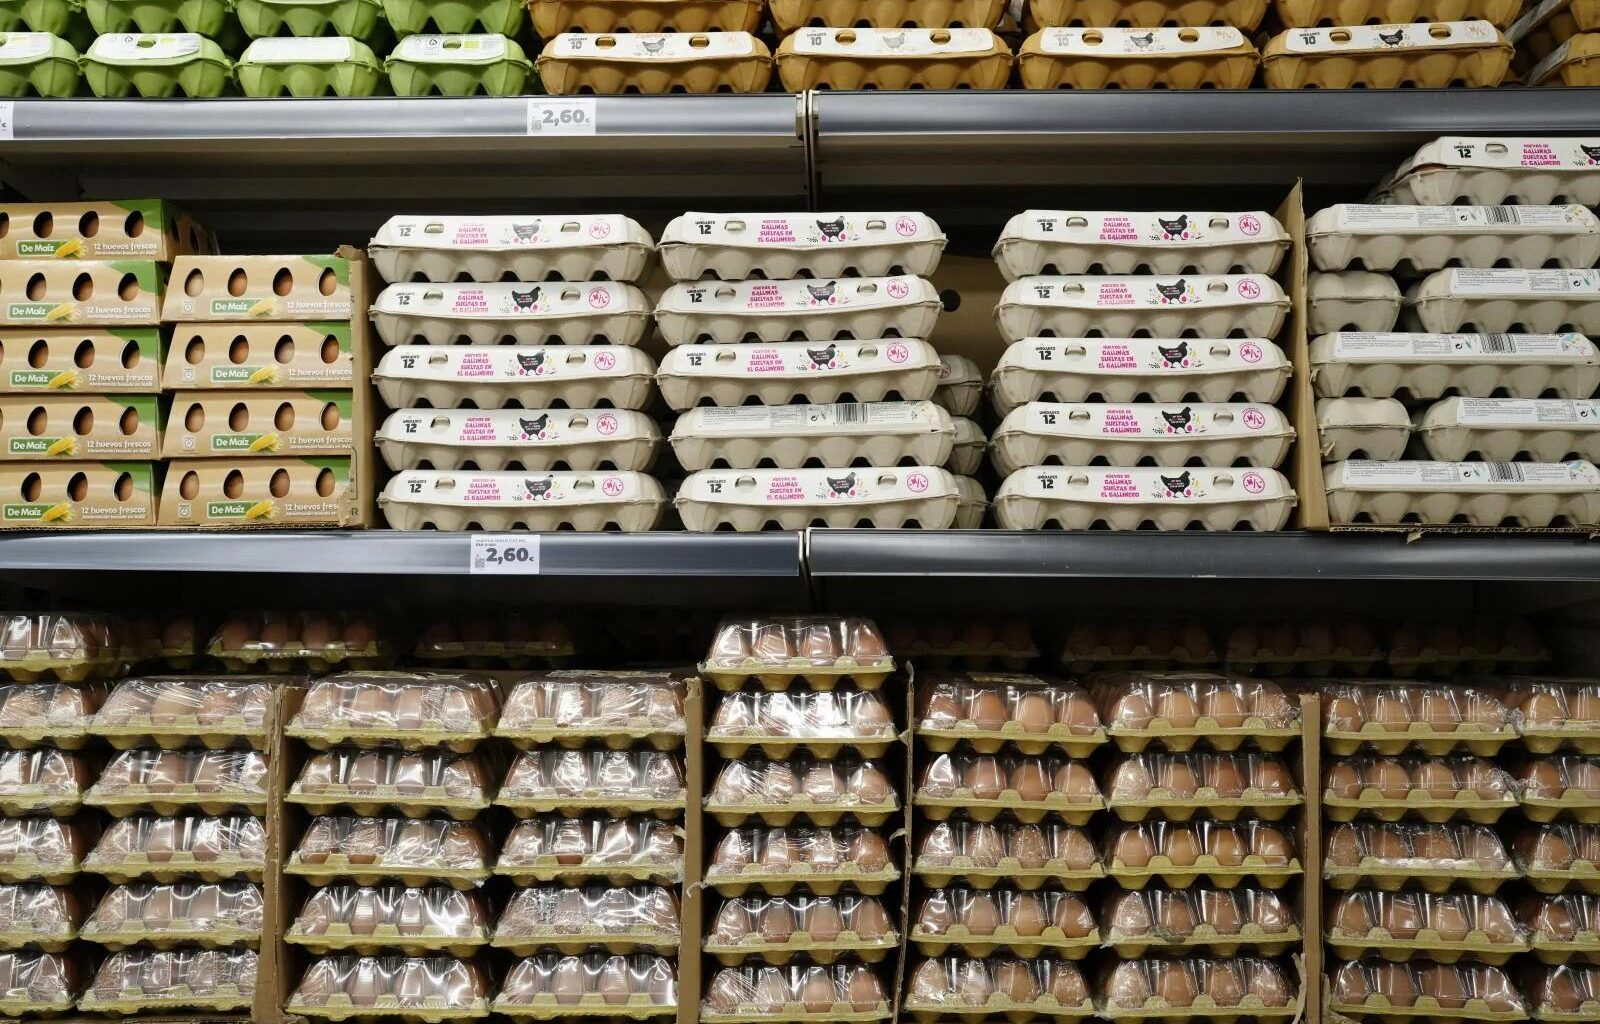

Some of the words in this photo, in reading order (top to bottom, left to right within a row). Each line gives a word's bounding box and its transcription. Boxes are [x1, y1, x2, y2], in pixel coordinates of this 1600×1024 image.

[810, 37, 821, 45] 10
[1303, 36, 1316, 45] 10
[1458, 149, 1471, 158] 12
[400, 228, 411, 236] 12
[698, 225, 711, 234] 12
[1041, 223, 1053, 232] 12
[131, 242, 156, 251] frescos
[690, 293, 702, 302] 12
[1037, 290, 1050, 298] 12
[324, 301, 350, 309] frescos
[399, 296, 410, 305] 12
[124, 306, 151, 314] frescos
[1038, 351, 1052, 360] 12
[403, 359, 415, 368] 12
[690, 356, 702, 366] 12
[326, 368, 352, 377] frescos
[127, 374, 152, 382] frescos
[1043, 415, 1056, 424] 12
[405, 424, 417, 433] 12
[124, 441, 151, 449] frescos
[229, 438, 249, 446] Maíz
[1041, 479, 1054, 488] 12
[410, 484, 421, 493] 12
[710, 484, 722, 493] 12
[224, 506, 244, 514] Maíz
